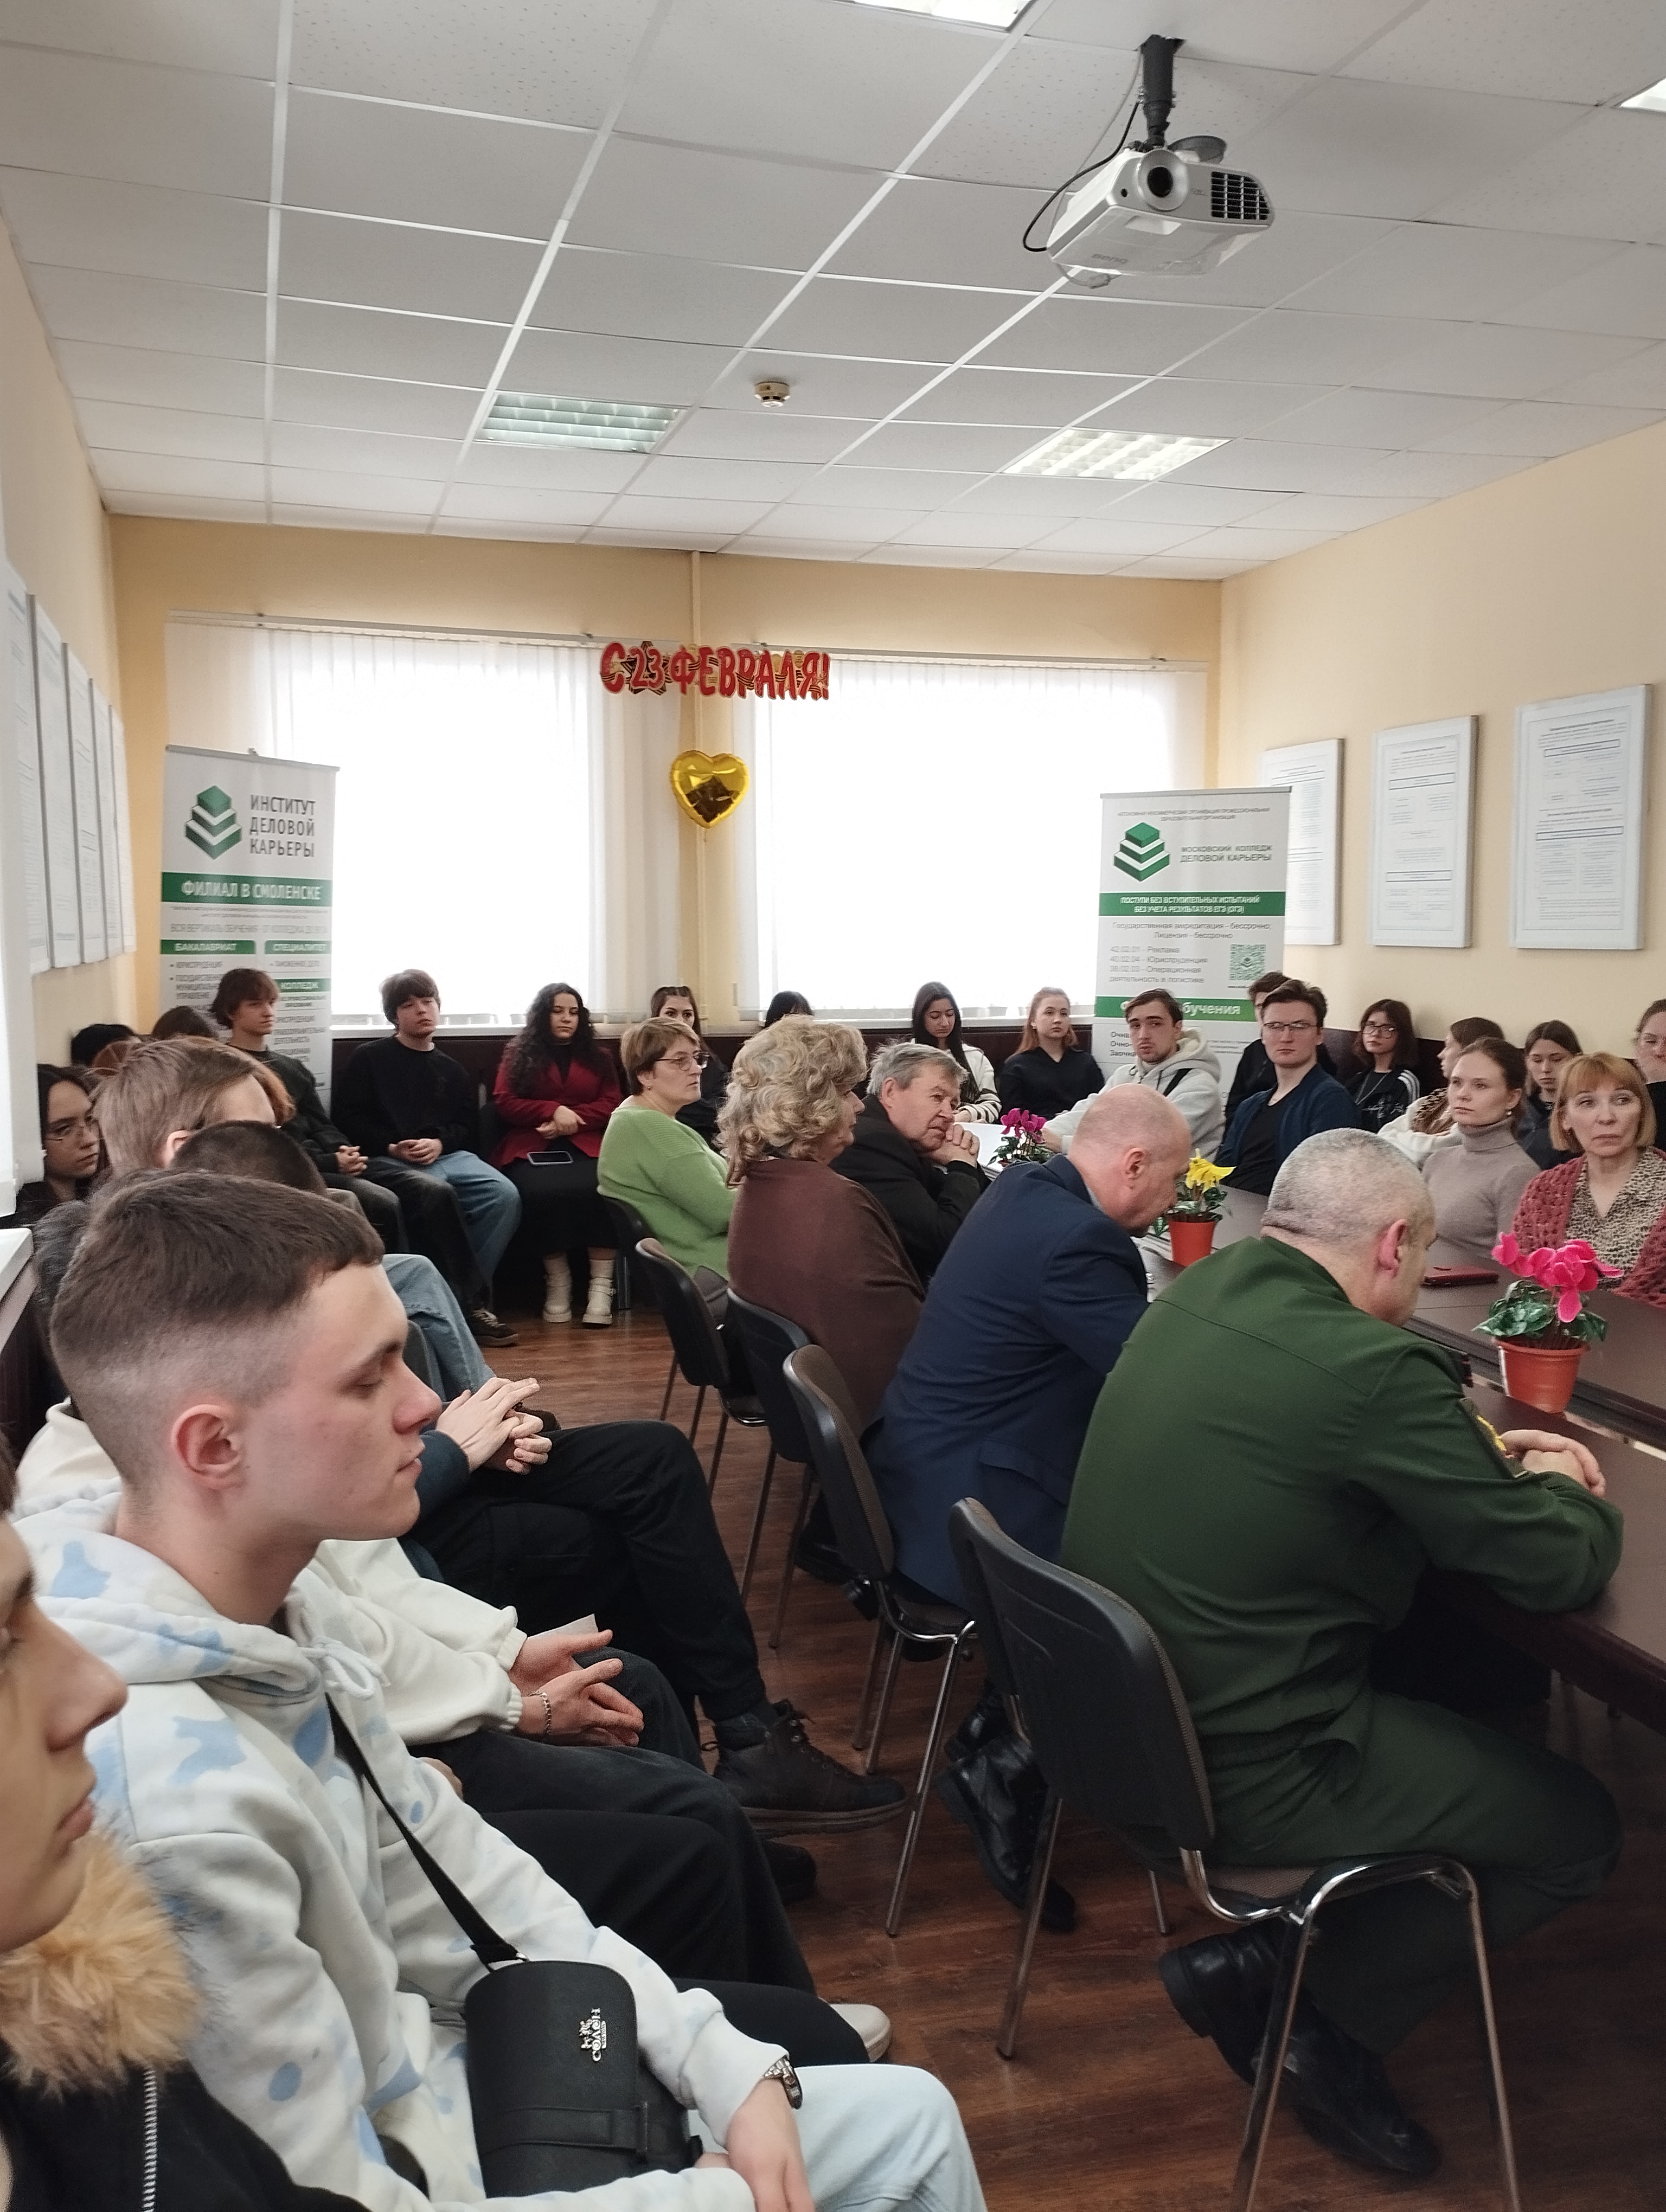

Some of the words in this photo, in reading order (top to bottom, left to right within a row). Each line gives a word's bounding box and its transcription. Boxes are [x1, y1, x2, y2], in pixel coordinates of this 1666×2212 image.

[600, 642, 626, 693] С
[628, 646, 665, 691] 23
[670, 645, 831, 700] ФЕВРАЛЯ!
[250, 794, 316, 815] ИНСТИТУТ
[249, 816, 315, 837] ДЕЛОВОЙ
[249, 839, 314, 857] КАРЬЕРЫ
[1180, 853, 1224, 863] ДЕЛОВОЙ
[181, 880, 238, 897] ФИЛИАЛ
[241, 883, 251, 898] В
[254, 883, 322, 901] СМОЛЕНСКЕ
[1120, 896, 1150, 904] ПОСТУПИ
[1163, 896, 1218, 904] ВСТУПИТЕЛЬНЫХ
[1219, 895, 1260, 904] ИСПЫТАНИЙ
[1227, 905, 1245, 915] (ОГЭ)
[1112, 922, 1172, 930] Государственная
[175, 943, 237, 951] БАКАЛАВРИАТ
[1148, 956, 1208, 964] Юриспруденция
[1147, 966, 1202, 974] Операционная
[1183, 1002, 1241, 1017] бучения
[591, 2008, 601, 2061] COACH
